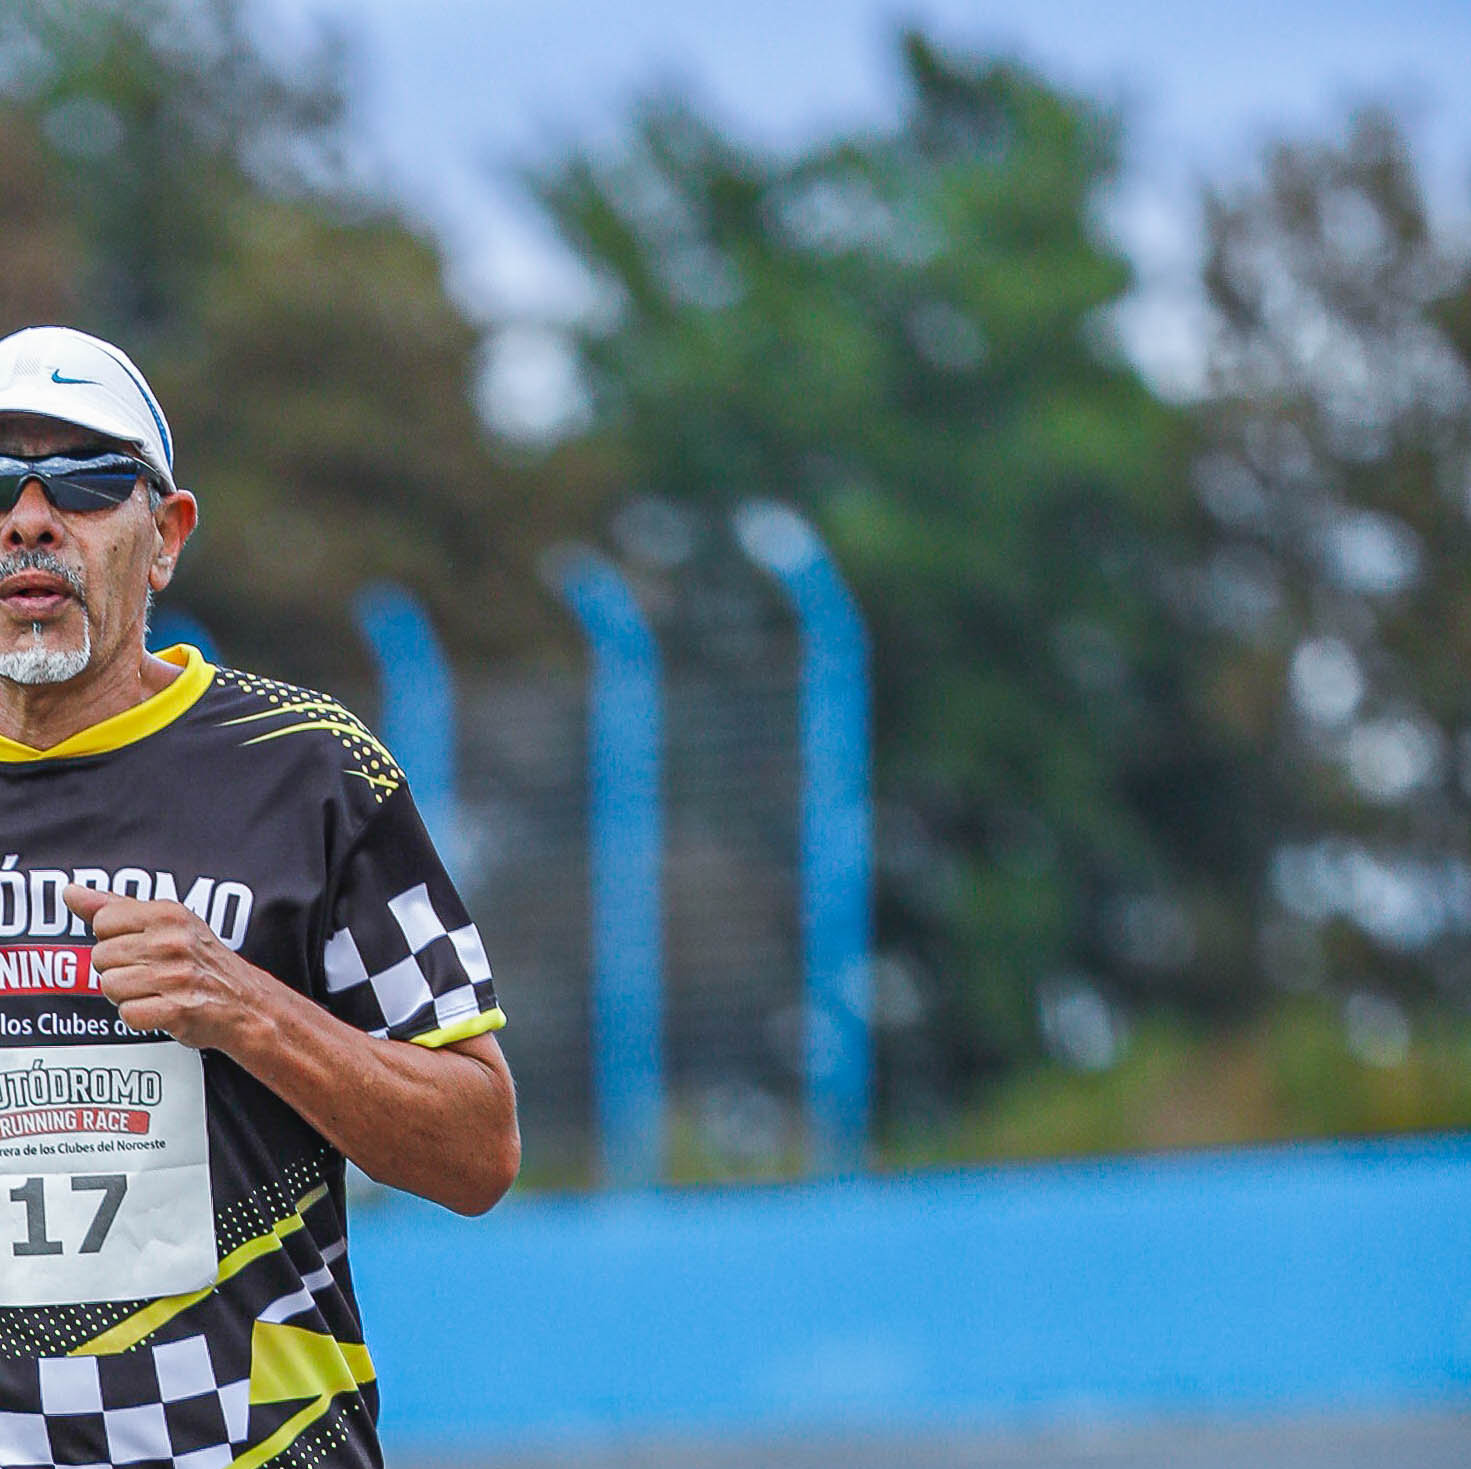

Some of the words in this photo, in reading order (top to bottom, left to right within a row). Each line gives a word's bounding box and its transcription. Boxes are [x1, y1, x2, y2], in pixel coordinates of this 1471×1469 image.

[0, 1012, 33, 1035] los
[37, 1012, 110, 1036] Clubes
[82, 1109, 131, 1132] RACE
[23, 1145, 37, 1156] de
[39, 1144, 55, 1155] los
[58, 1142, 94, 1154] Clubes
[97, 1141, 115, 1152] del
[117, 1139, 166, 1152] Noroeste
[9, 1174, 128, 1257] 17
